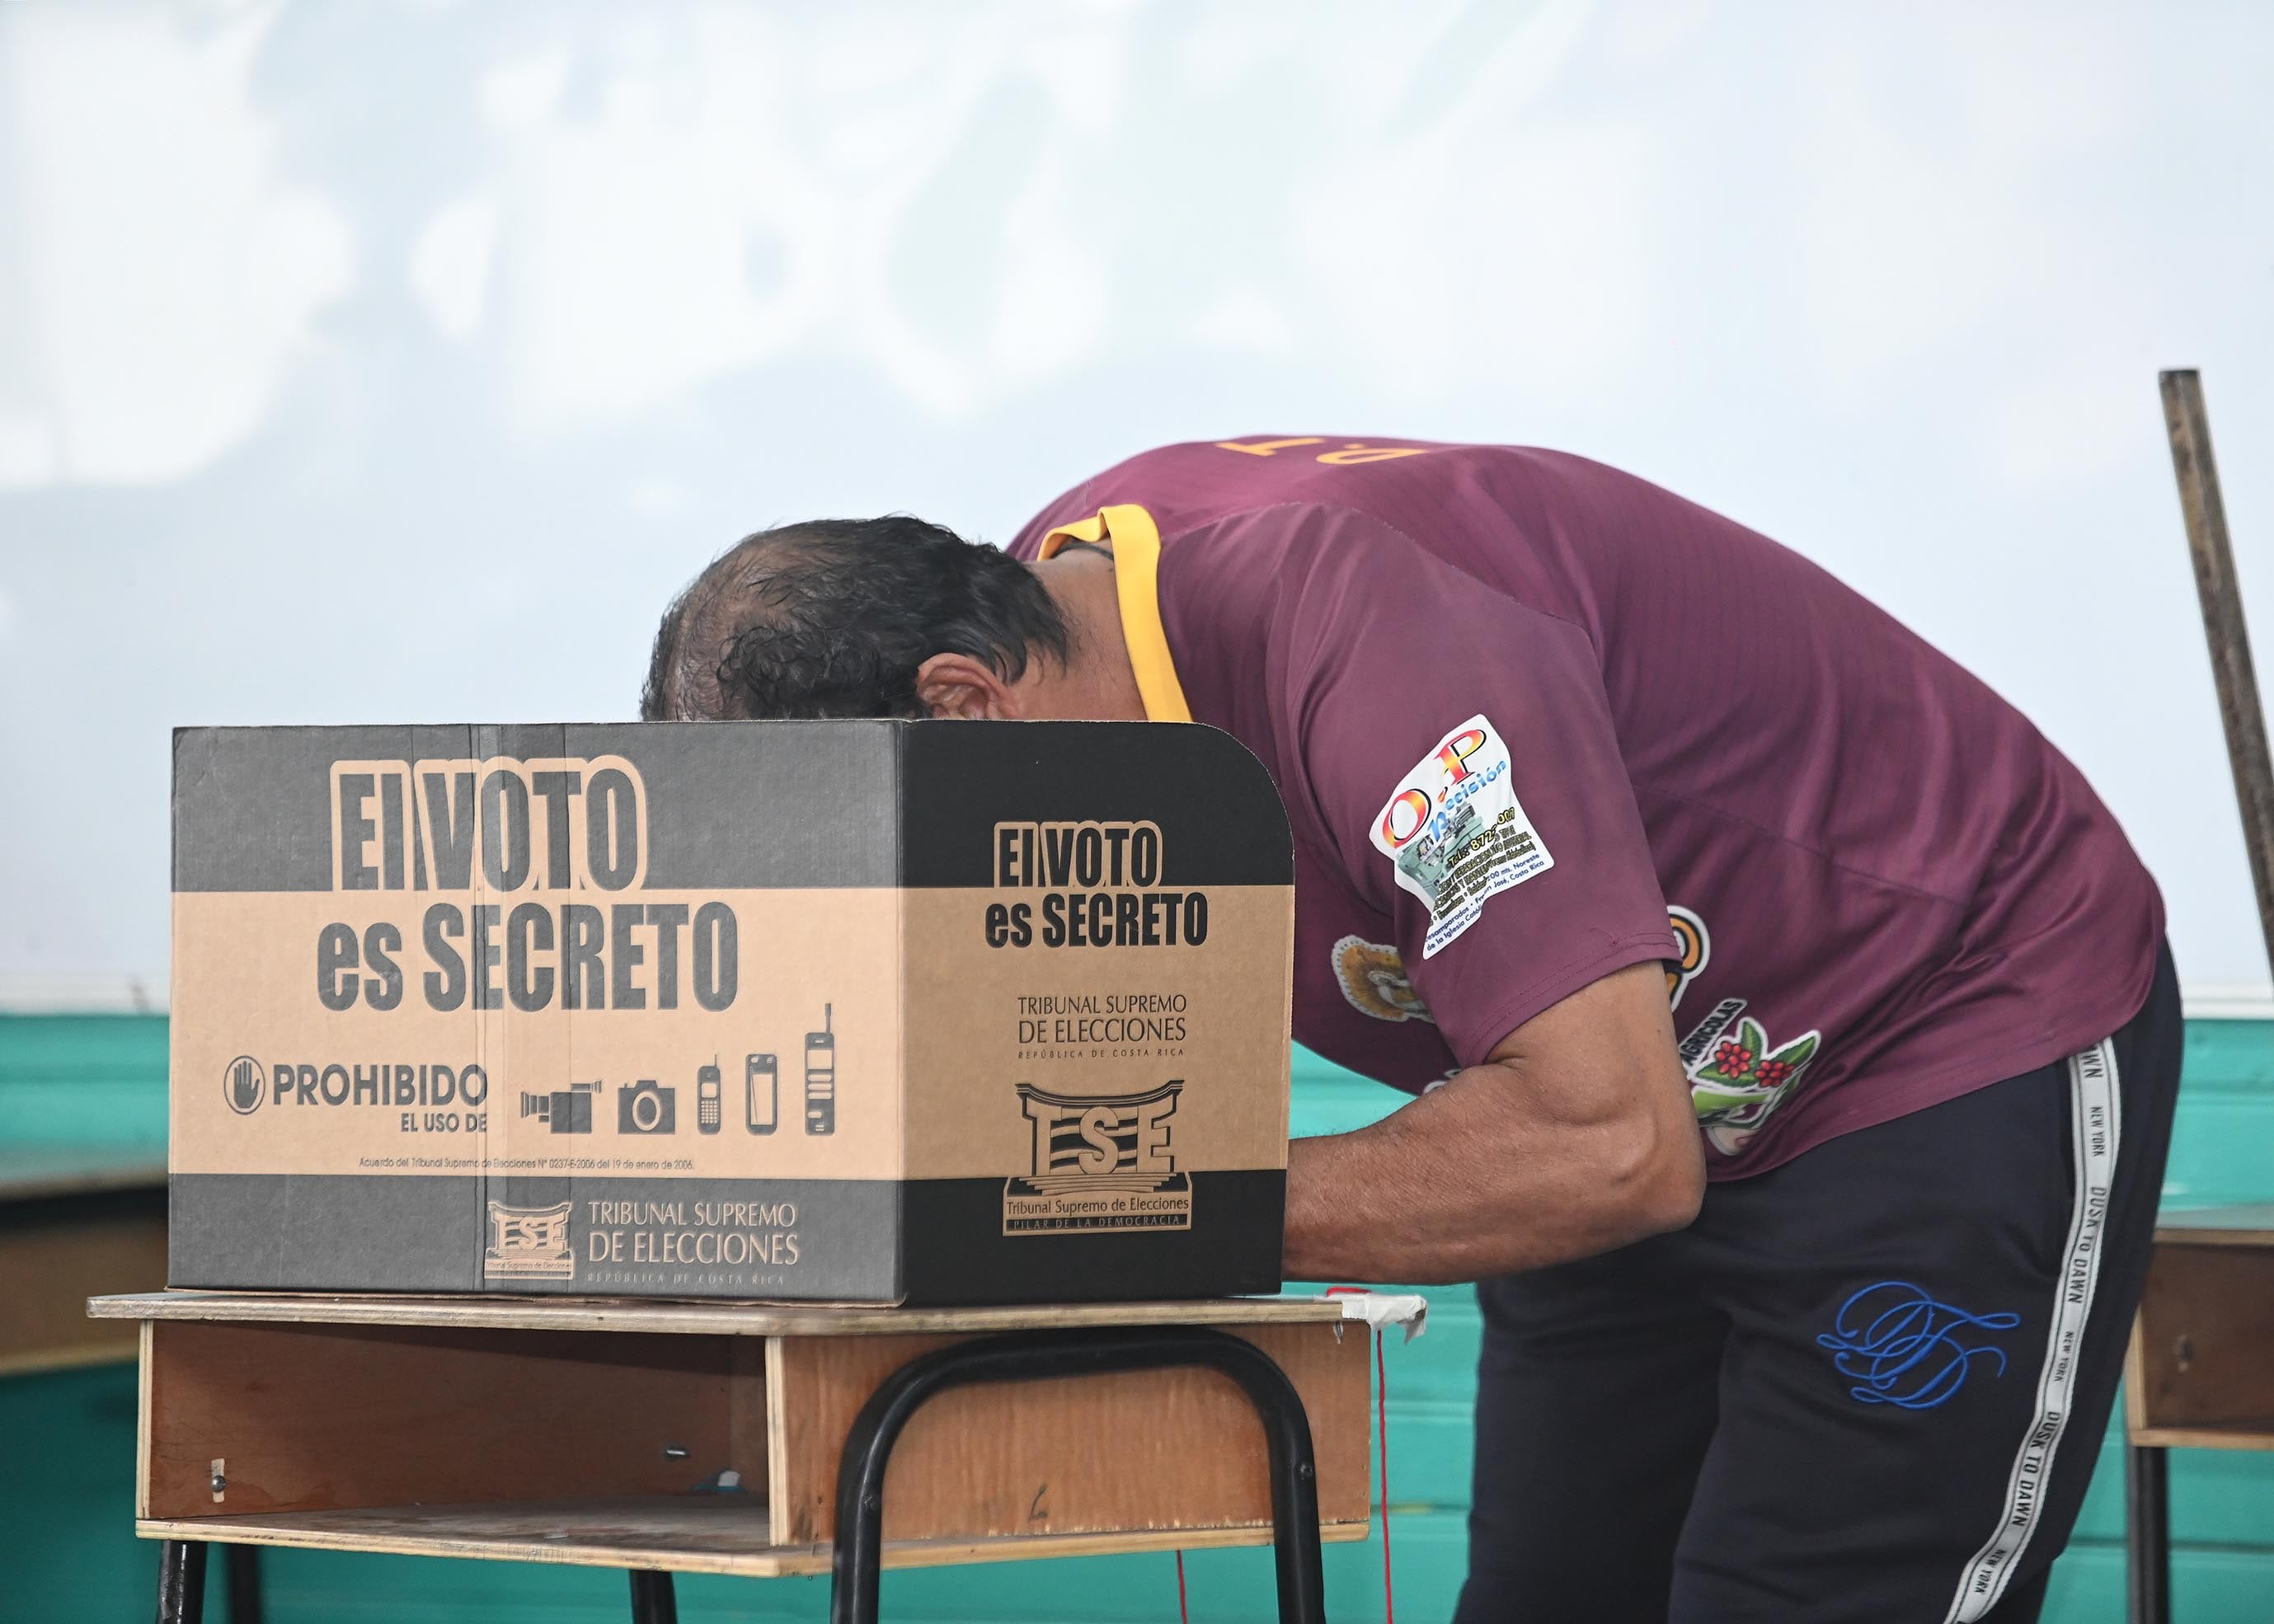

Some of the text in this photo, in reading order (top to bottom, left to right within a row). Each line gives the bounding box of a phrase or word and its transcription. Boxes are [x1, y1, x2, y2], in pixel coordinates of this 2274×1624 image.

[422, 767, 640, 891] VOTO
[1045, 826, 1158, 888] VOTO
[1513, 853, 1540, 870] Noreste
[1444, 921, 1465, 938] Iglesia
[1510, 869, 1529, 880] Costa
[1529, 861, 1544, 871] Rica
[985, 892, 1208, 949] es SECRETO
[317, 901, 739, 1012] es SECRETO
[1017, 994, 1187, 1015] TRIBUNAL SUPREMO
[1018, 1017, 1186, 1044] DE ELECCIONES
[1018, 1049, 1184, 1059] REPÚBLICA DE COSTA RICA
[273, 1063, 488, 1106] PROHIBIDO
[401, 1113, 487, 1133] EL USO DE
[2090, 1106, 2105, 1157] NEW YORK
[359, 1157, 394, 1167] Acuerdo
[396, 1157, 409, 1167] del
[411, 1157, 443, 1167] Tribunal
[444, 1158, 479, 1169] Supremo
[482, 1158, 492, 1168] de
[597, 1159, 610, 1169] del
[613, 1160, 621, 1169] 19
[623, 1160, 634, 1169] de
[661, 1160, 673, 1170] de
[674, 1160, 694, 1170] 2006.
[588, 1201, 797, 1227] TRIBUNAL SUPREMO
[1007, 1198, 1189, 1216] Tribunal Supremo de Elecciones
[1014, 1216, 1181, 1230] PILAR DE LA DEMOCRACIA
[589, 1232, 801, 1265] DE ELECCIONES
[2068, 1187, 2107, 1304] DUSK TO DAWN
[587, 1272, 784, 1285] REPÚBLICA DE COSTA RICA
[2062, 1331, 2074, 1354] NEW
[2013, 1411, 2060, 1527] DUSK TO DAWN
[1975, 1549, 2007, 1595] NEW YORK
